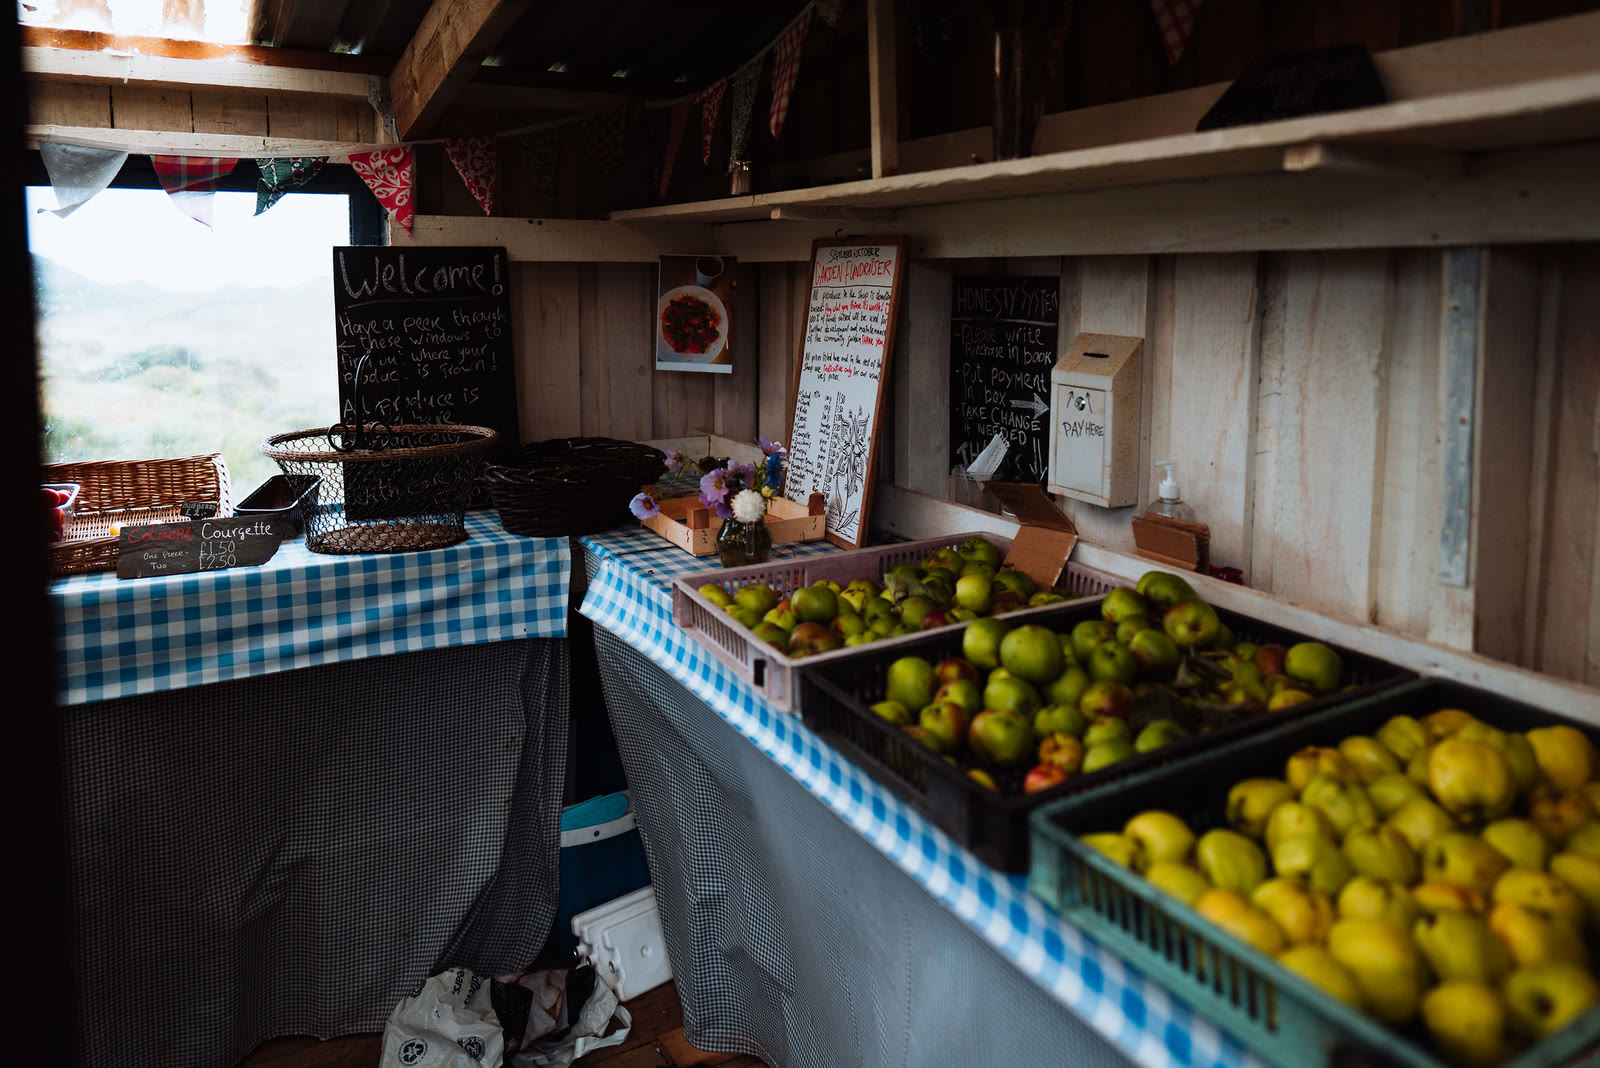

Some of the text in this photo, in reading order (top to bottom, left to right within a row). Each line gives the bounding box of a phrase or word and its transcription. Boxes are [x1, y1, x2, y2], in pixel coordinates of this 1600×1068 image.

[856, 247, 880, 259] OCTOBER
[338, 251, 504, 299] Welcome!
[815, 258, 892, 286] GARDEN FUNDRAISER
[822, 290, 841, 305] produce
[870, 291, 875, 300] is
[957, 283, 1019, 319] HONESTY
[339, 305, 508, 336] Have a peek through
[861, 311, 867, 322] be
[359, 326, 501, 351] these windows to
[825, 323, 849, 336] development
[850, 322, 858, 332] and
[961, 324, 997, 346] Please
[1006, 327, 1044, 346] write
[824, 335, 845, 347] community
[411, 349, 451, 362] where
[458, 344, 488, 364] your
[1008, 343, 1019, 365] in
[1023, 347, 1052, 366] book
[417, 363, 429, 379] is
[844, 364, 852, 378] only
[963, 362, 984, 384] Put
[463, 388, 479, 405] is
[964, 384, 1007, 407] in box
[961, 402, 988, 420] TAKE
[991, 406, 1042, 432] CHANGE
[1062, 419, 1104, 438] PAY HERE
[201, 522, 273, 541] Courgette
[143, 552, 159, 561] One
[200, 541, 236, 556] £1.50
[150, 562, 167, 570] Two
[199, 554, 237, 570] £2.50
